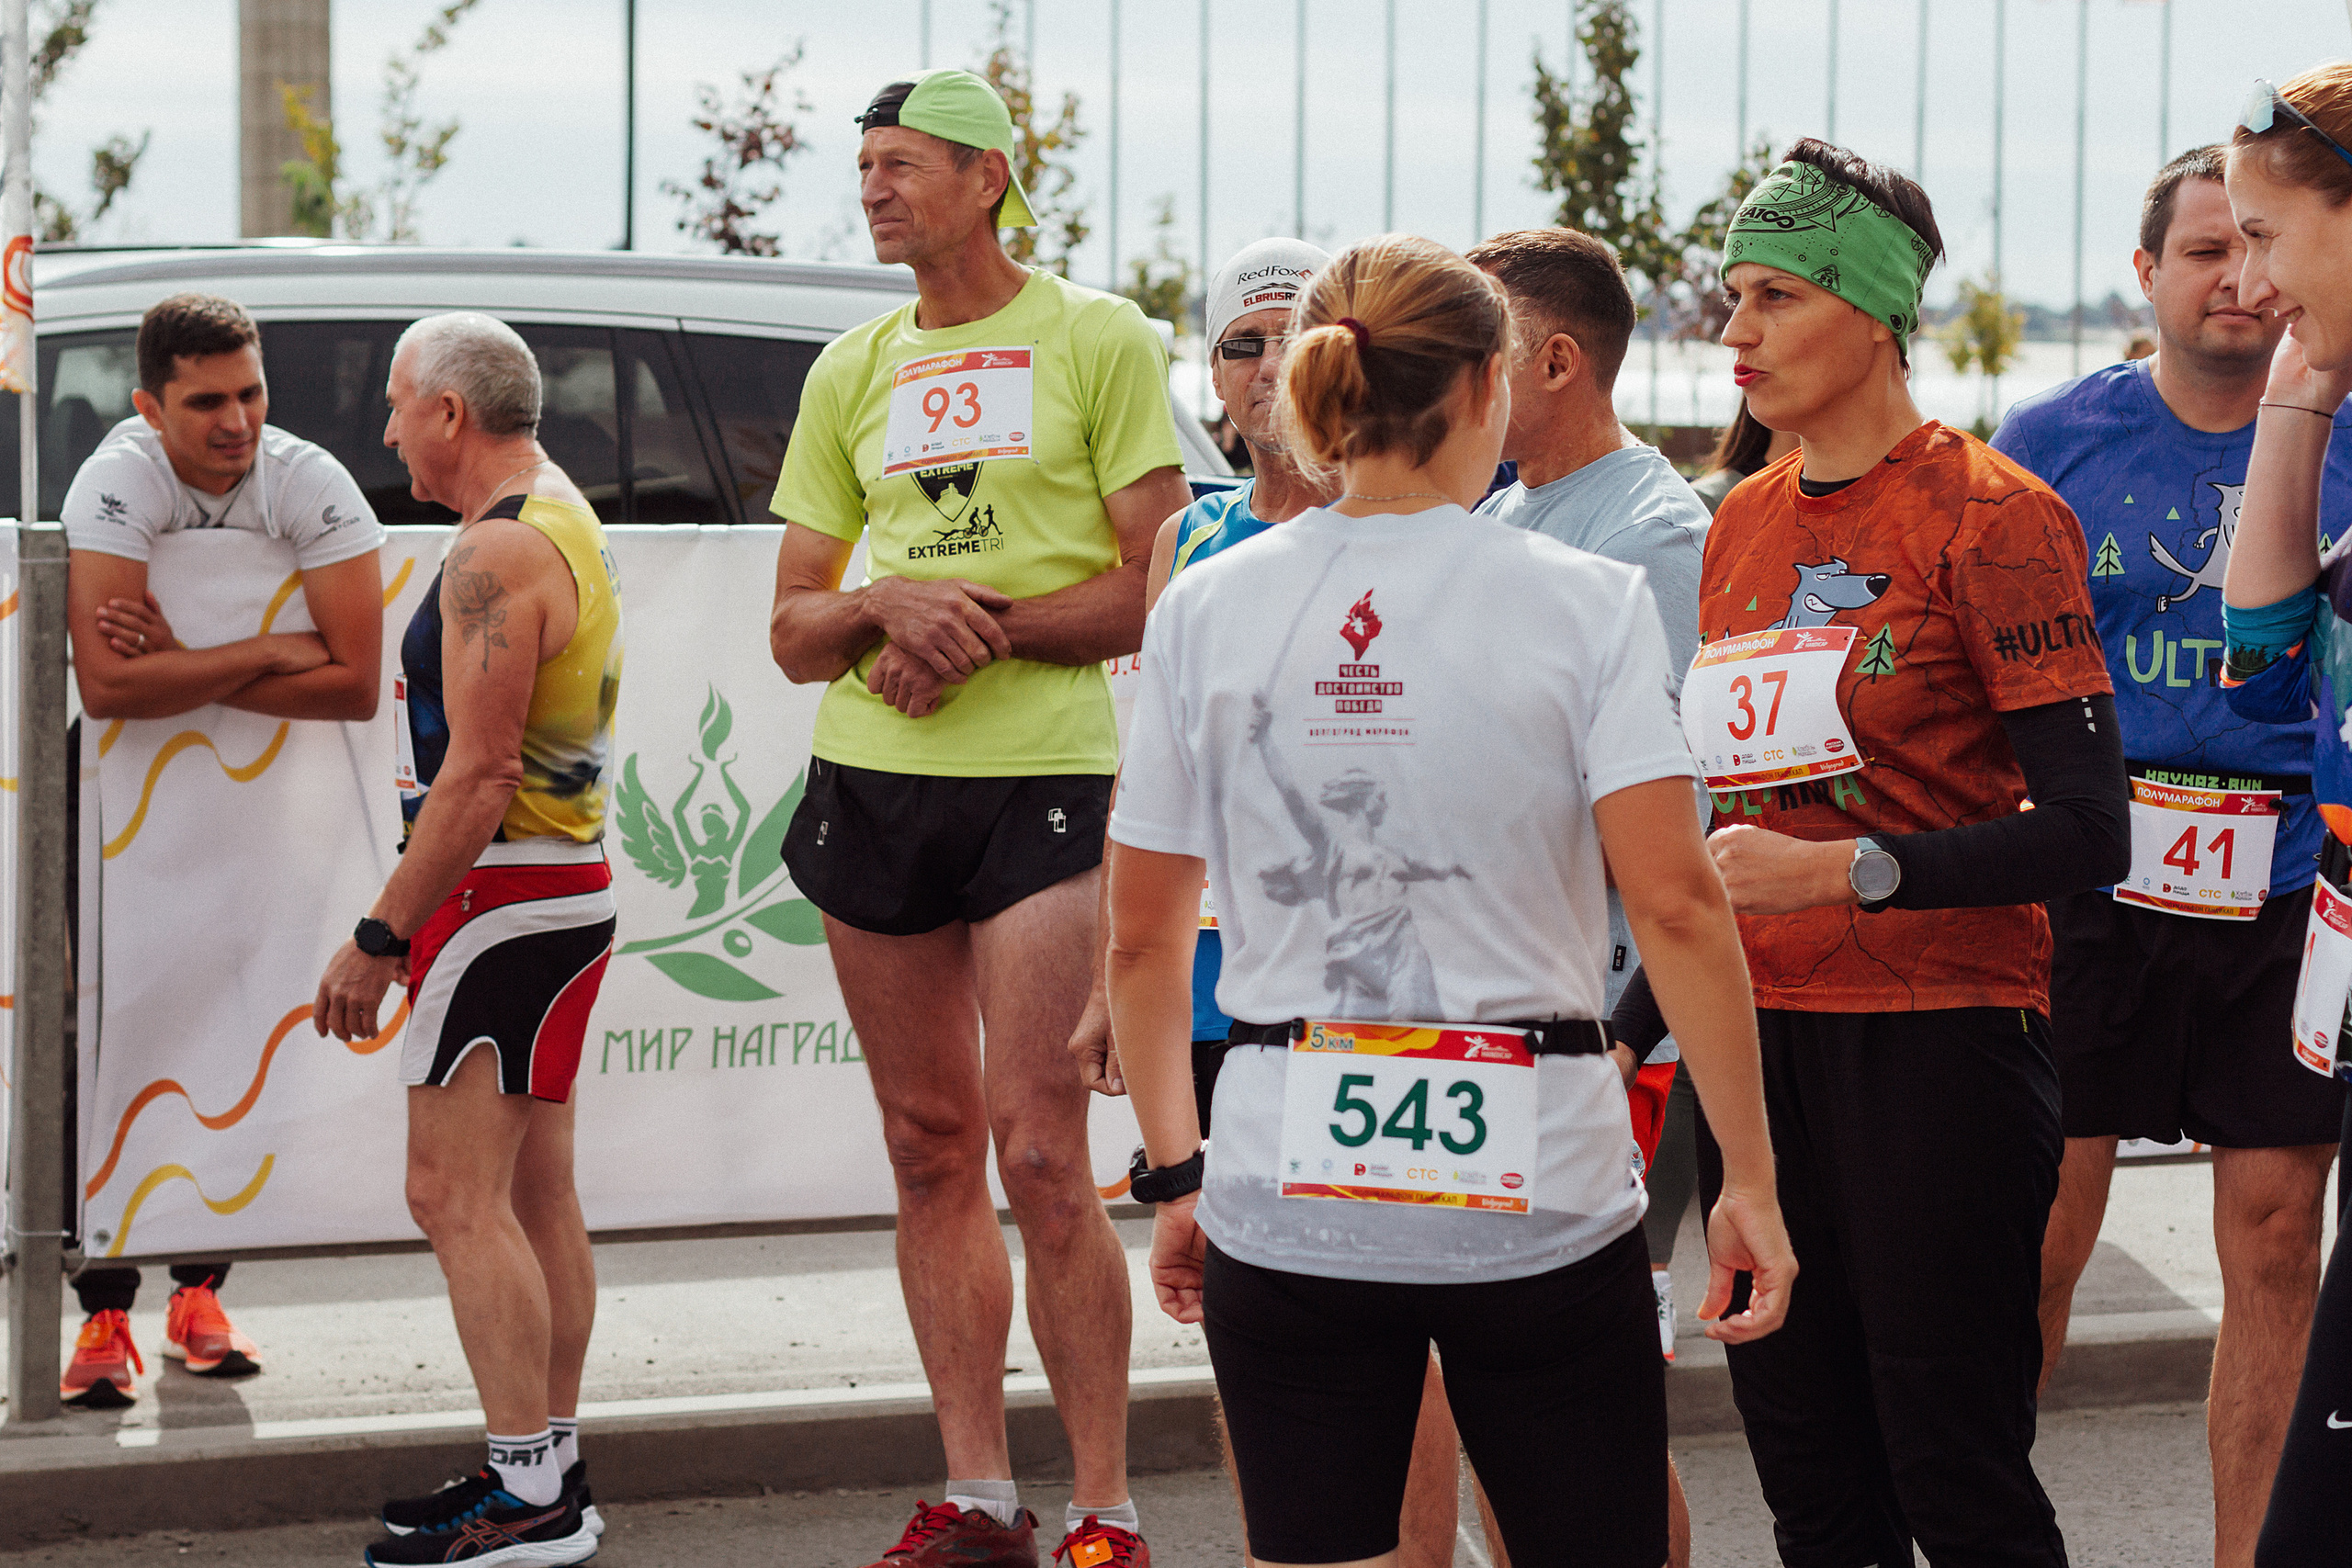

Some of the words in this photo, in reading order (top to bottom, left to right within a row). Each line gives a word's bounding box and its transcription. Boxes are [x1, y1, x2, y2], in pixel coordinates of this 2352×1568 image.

[922, 382, 982, 434] 93
[920, 463, 974, 478] EXTREME
[1703, 637, 1775, 659] ПОЛУМАРАФОН
[1340, 665, 1378, 677] ЧЕСТЬ
[1317, 682, 1402, 694] ДОСТОИНСТВО
[1336, 700, 1382, 712] ПОБЕДА
[1727, 671, 1788, 740] 37
[2137, 786, 2220, 807] ПОЛУМАРАФОН
[2163, 825, 2235, 879] 41
[599, 1027, 693, 1074] МИР
[1329, 1074, 1487, 1155] 543
